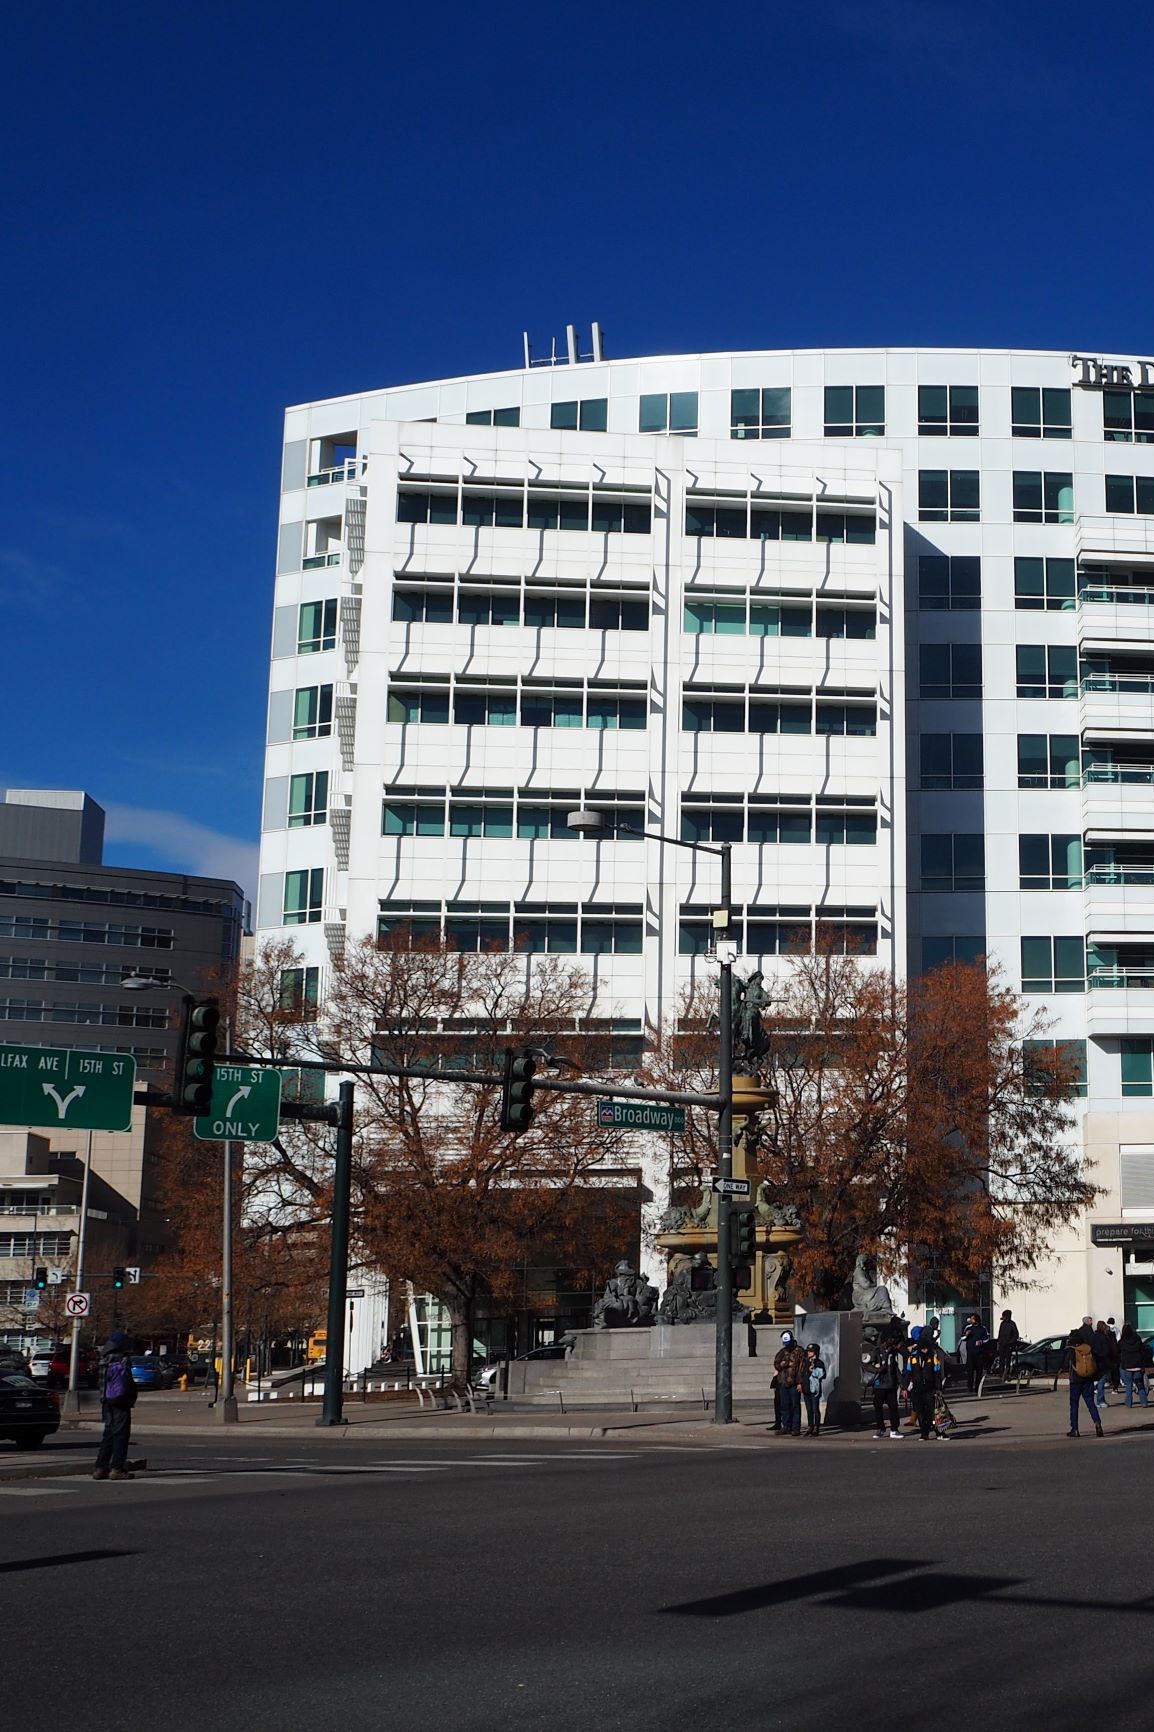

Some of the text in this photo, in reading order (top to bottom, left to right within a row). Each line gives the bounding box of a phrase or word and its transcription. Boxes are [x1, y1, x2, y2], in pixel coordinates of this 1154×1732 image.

[38, 1056, 59, 1071] AVE
[79, 1059, 124, 1075] 15TH ST
[216, 1067, 264, 1083] 15TH ST
[614, 1105, 674, 1130] Broadway
[212, 1121, 261, 1137] ONLY
[723, 1182, 734, 1190] ONE
[1096, 1227, 1129, 1237] prepare
[1131, 1226, 1143, 1235] for
